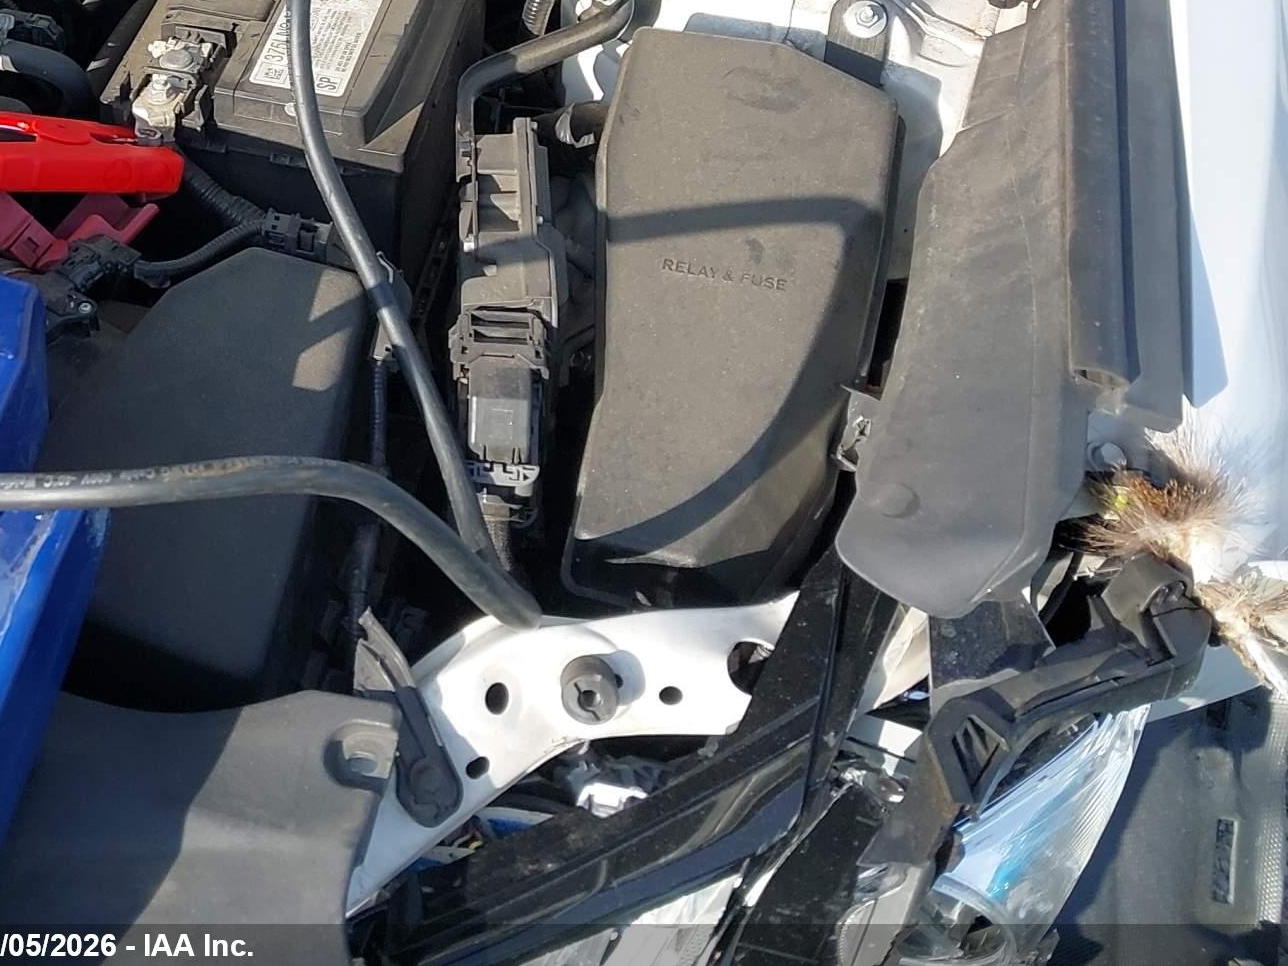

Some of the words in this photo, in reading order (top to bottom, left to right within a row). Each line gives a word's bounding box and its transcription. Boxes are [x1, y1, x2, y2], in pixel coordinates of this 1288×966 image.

[316, 76, 337, 90] SP
[662, 258, 718, 279] RELAY
[722, 270, 734, 282] &
[741, 273, 788, 292] FUSE
